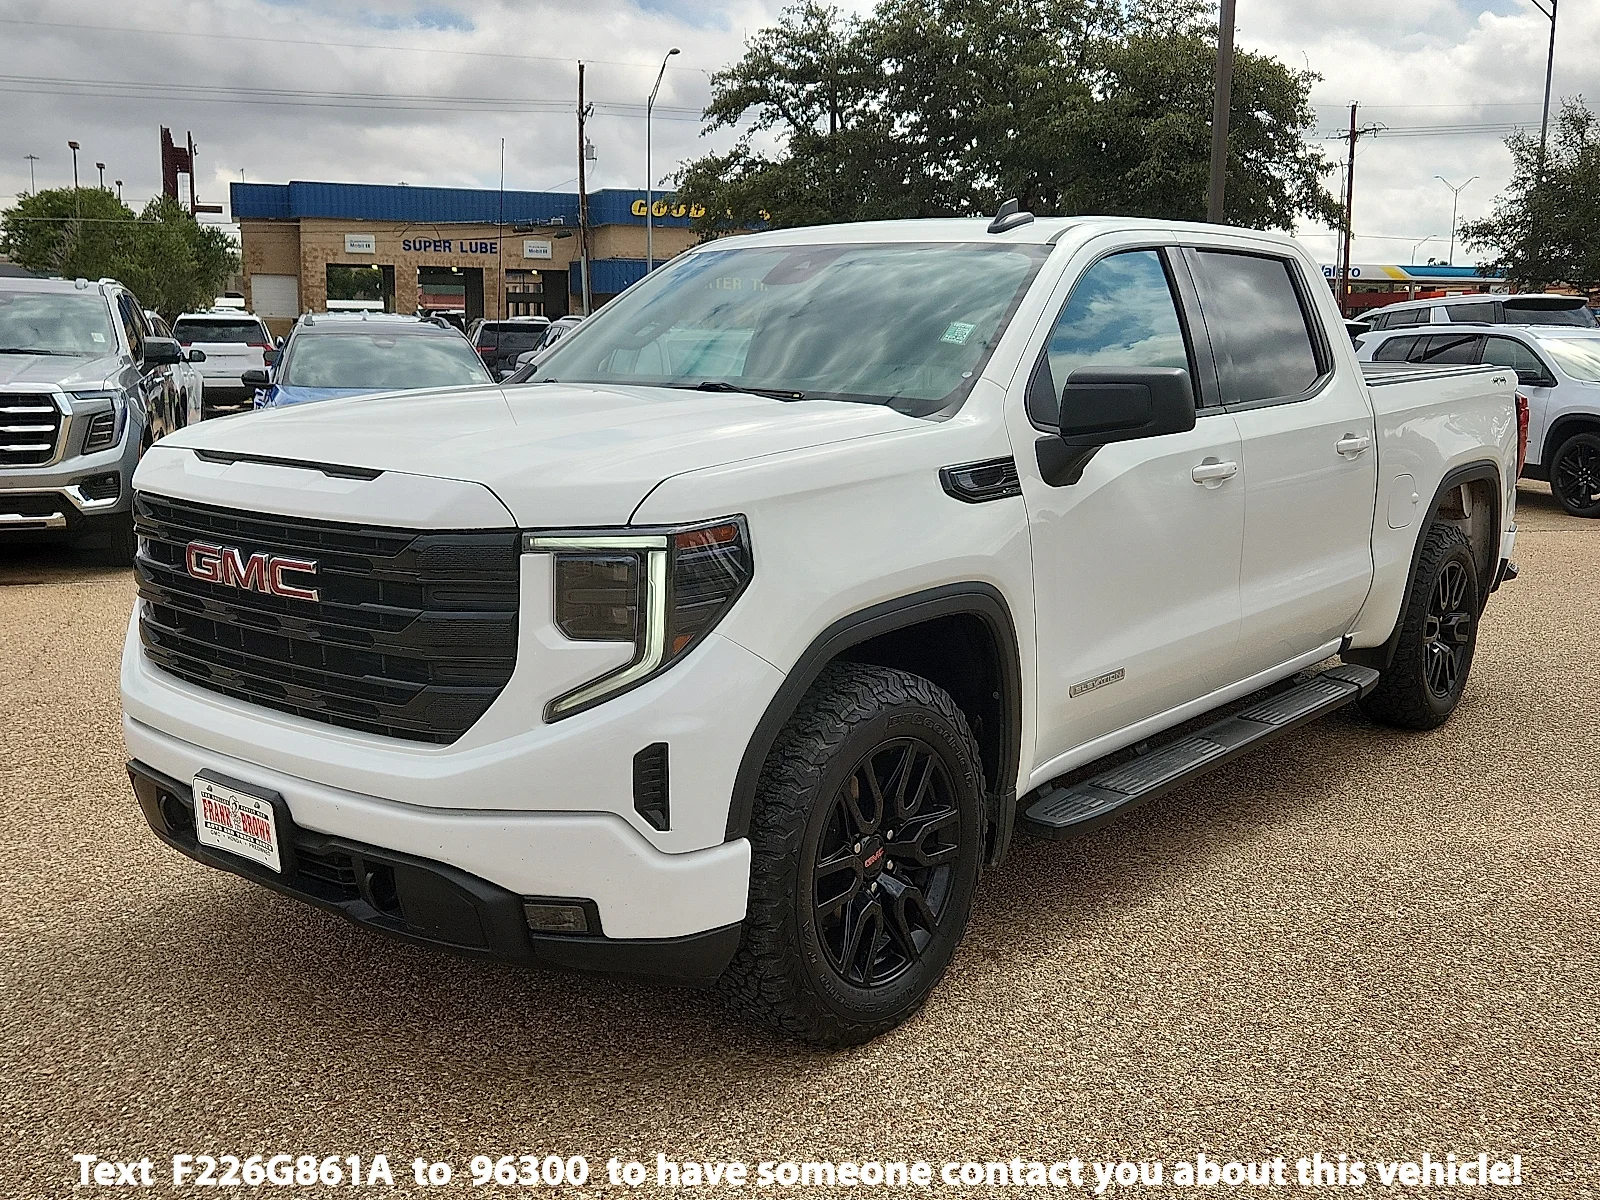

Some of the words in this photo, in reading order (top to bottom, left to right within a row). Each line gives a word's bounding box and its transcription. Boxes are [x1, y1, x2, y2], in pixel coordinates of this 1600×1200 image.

[402, 239, 452, 252] SUPER
[460, 241, 498, 254] LUBE
[186, 541, 319, 602] GMC
[1073, 669, 1126, 695] ELEVATION
[201, 798, 233, 828] FRANK
[240, 811, 272, 844] BROWN
[864, 846, 885, 868] GMC
